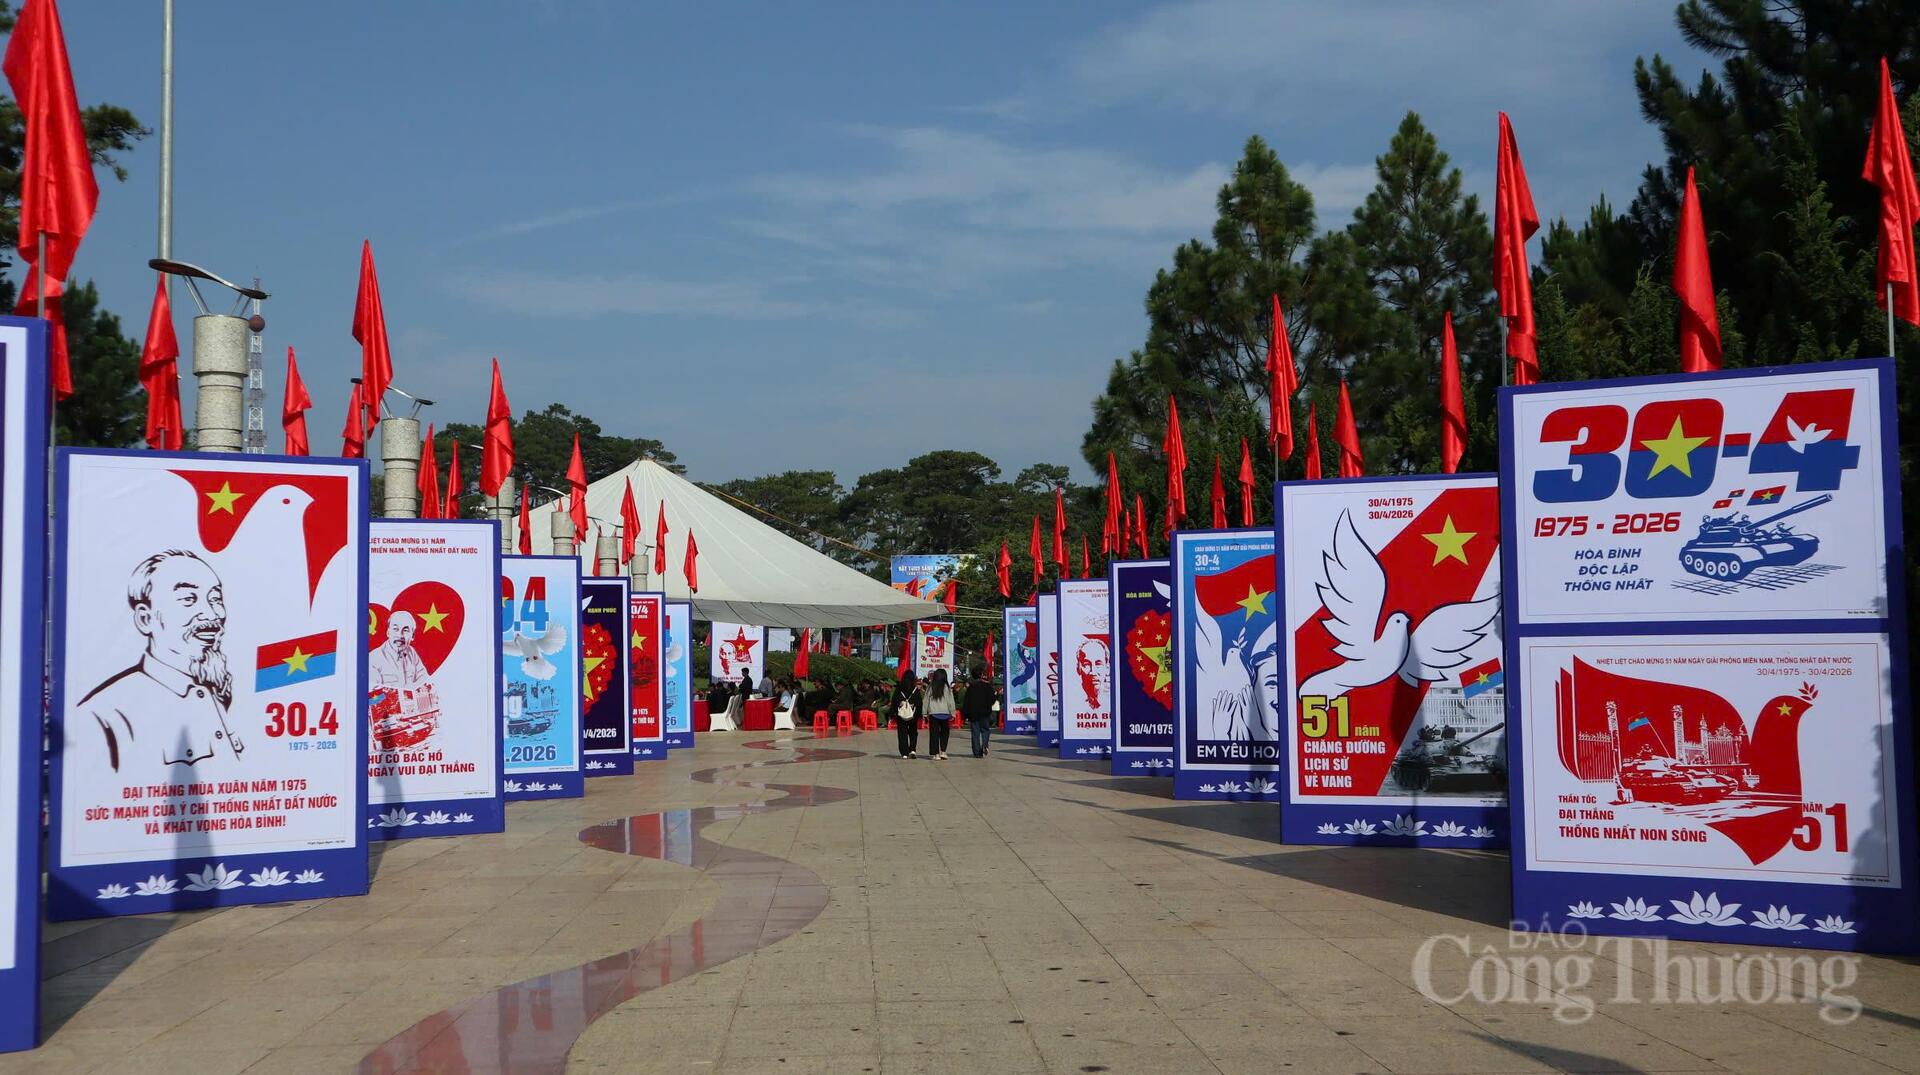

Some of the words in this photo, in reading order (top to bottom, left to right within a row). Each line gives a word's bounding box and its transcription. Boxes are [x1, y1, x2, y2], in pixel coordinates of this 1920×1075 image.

[1533, 388, 1861, 504] 30-4
[1368, 498, 1414, 507] 30/4/1975
[1368, 510, 1414, 519] 30/4/2026
[1533, 515, 1588, 538] 1975
[1612, 512, 1682, 535] 2026
[369, 537, 381, 545] IỆT
[382, 537, 399, 545] CHÀO
[401, 537, 420, 545] MỪNG
[431, 537, 446, 545] NĂM
[408, 546, 429, 554] THỐNG
[1608, 547, 1641, 559] BÌNH
[1195, 554, 1220, 566] 30-4
[1579, 563, 1608, 577] ĐỘC
[1612, 562, 1639, 576] LẬP
[1564, 579, 1611, 591] THỐNG
[1615, 577, 1654, 591] NHẤT
[1743, 656, 1758, 664] MIỀN
[1776, 656, 1798, 664] THỐNG
[1800, 656, 1816, 664] NHẤT
[1818, 656, 1832, 664] ĐẤT
[1832, 656, 1852, 664] NƯỚC
[1757, 668, 1800, 676] 30/4/1975
[1808, 668, 1852, 676] 30/4/2026
[1013, 705, 1028, 714] NIỀM
[1077, 711, 1098, 720] HÒA
[1301, 694, 1351, 738] 51
[1355, 725, 1380, 736] năm
[265, 701, 339, 737] 30.4
[1077, 721, 1106, 730] HẠNH
[1129, 723, 1173, 735] 30/4/1975
[288, 742, 309, 751] 1975
[316, 740, 337, 750] 2026
[1197, 745, 1217, 758] EM
[1221, 742, 1249, 758] YÊU
[1304, 739, 1342, 756] CHẶNG
[1346, 739, 1386, 754] ĐƯỜNG
[403, 751, 425, 763] BÁC
[428, 748, 443, 762] HỒ
[398, 766, 415, 776] VUI
[419, 764, 437, 776] ĐẠI
[440, 760, 475, 773] THẮNG
[1304, 757, 1330, 772] LỊCH
[1333, 755, 1349, 771] SỬ
[1321, 775, 1352, 788] VANG
[123, 786, 143, 801] ĐẠI
[146, 781, 184, 797] THẮNG
[188, 780, 214, 796] MÙA
[218, 779, 248, 794] XUÂN
[252, 778, 277, 793] NĂM
[281, 779, 307, 791] 1975
[1558, 794, 1579, 804] THẦN
[1582, 793, 1597, 804] TỐC
[85, 805, 109, 821] SỨC
[113, 805, 149, 821] MẠNH
[153, 800, 176, 817] CỦA
[179, 800, 186, 815] Ý
[190, 799, 209, 815] CHÍ
[213, 796, 249, 814] THỐNG
[252, 795, 281, 811] NHẤT
[285, 794, 305, 810] ĐẤT
[308, 793, 337, 809] NƯỚC
[1803, 802, 1823, 813] NĂM
[1559, 809, 1576, 822] ĐẠI
[1580, 806, 1614, 821] THẮNG
[145, 820, 159, 835] VÀ
[163, 818, 193, 834] KHÁT
[196, 818, 226, 834] VỌNG
[230, 814, 252, 829] HÒA
[256, 814, 286, 828] BÌNH!
[1559, 822, 1600, 839] THỐNG
[1603, 823, 1636, 840] NHẤT
[1640, 828, 1667, 841] NON
[1671, 826, 1707, 843] SÔNG
